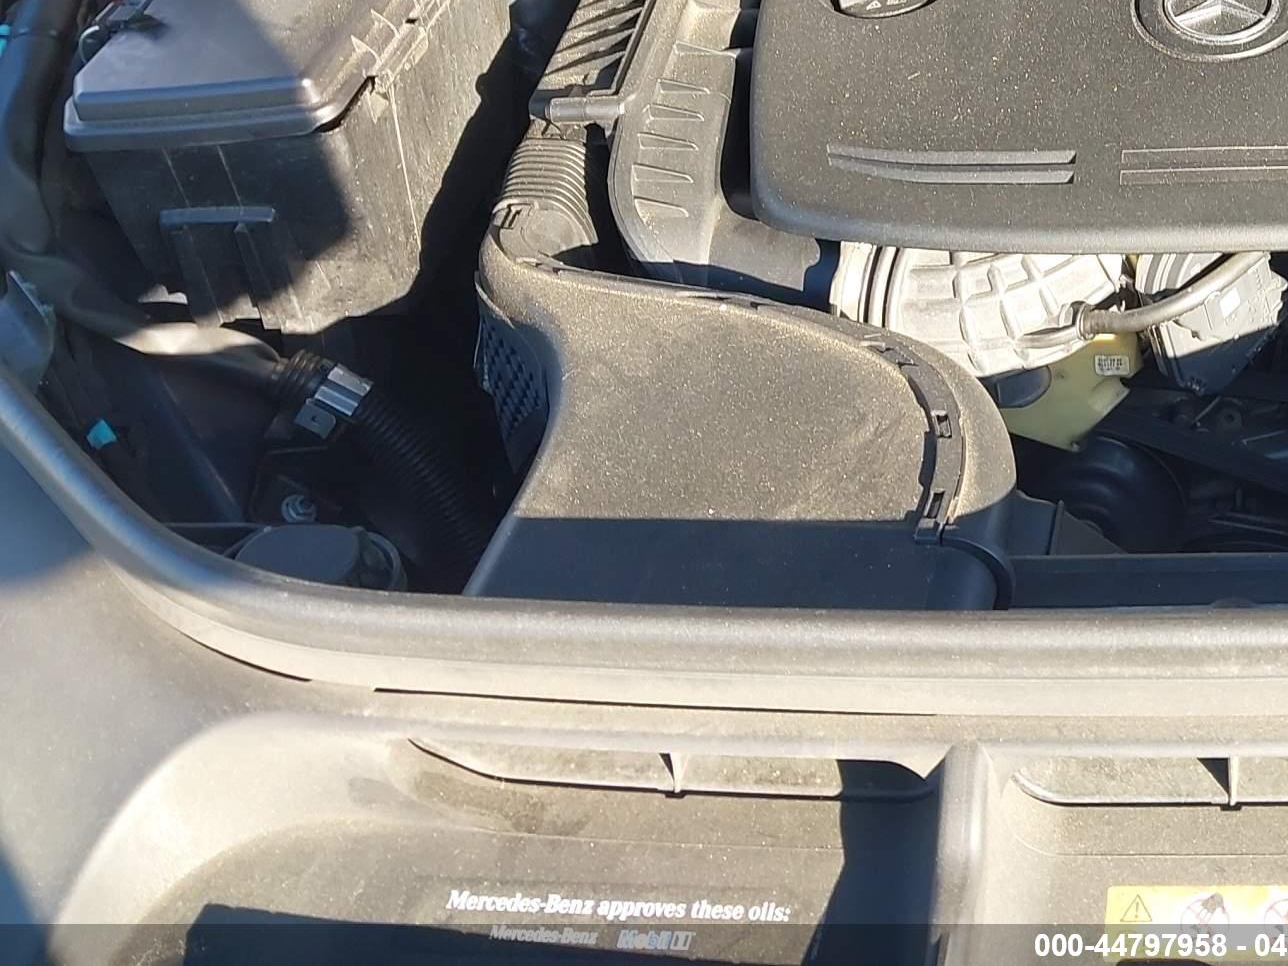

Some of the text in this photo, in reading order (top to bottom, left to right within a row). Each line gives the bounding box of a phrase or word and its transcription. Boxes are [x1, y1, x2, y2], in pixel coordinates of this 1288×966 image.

[446, 889, 792, 922] Mercedes-Benz approves these oils:
[488, 924, 599, 945] Mercedes-Benz
